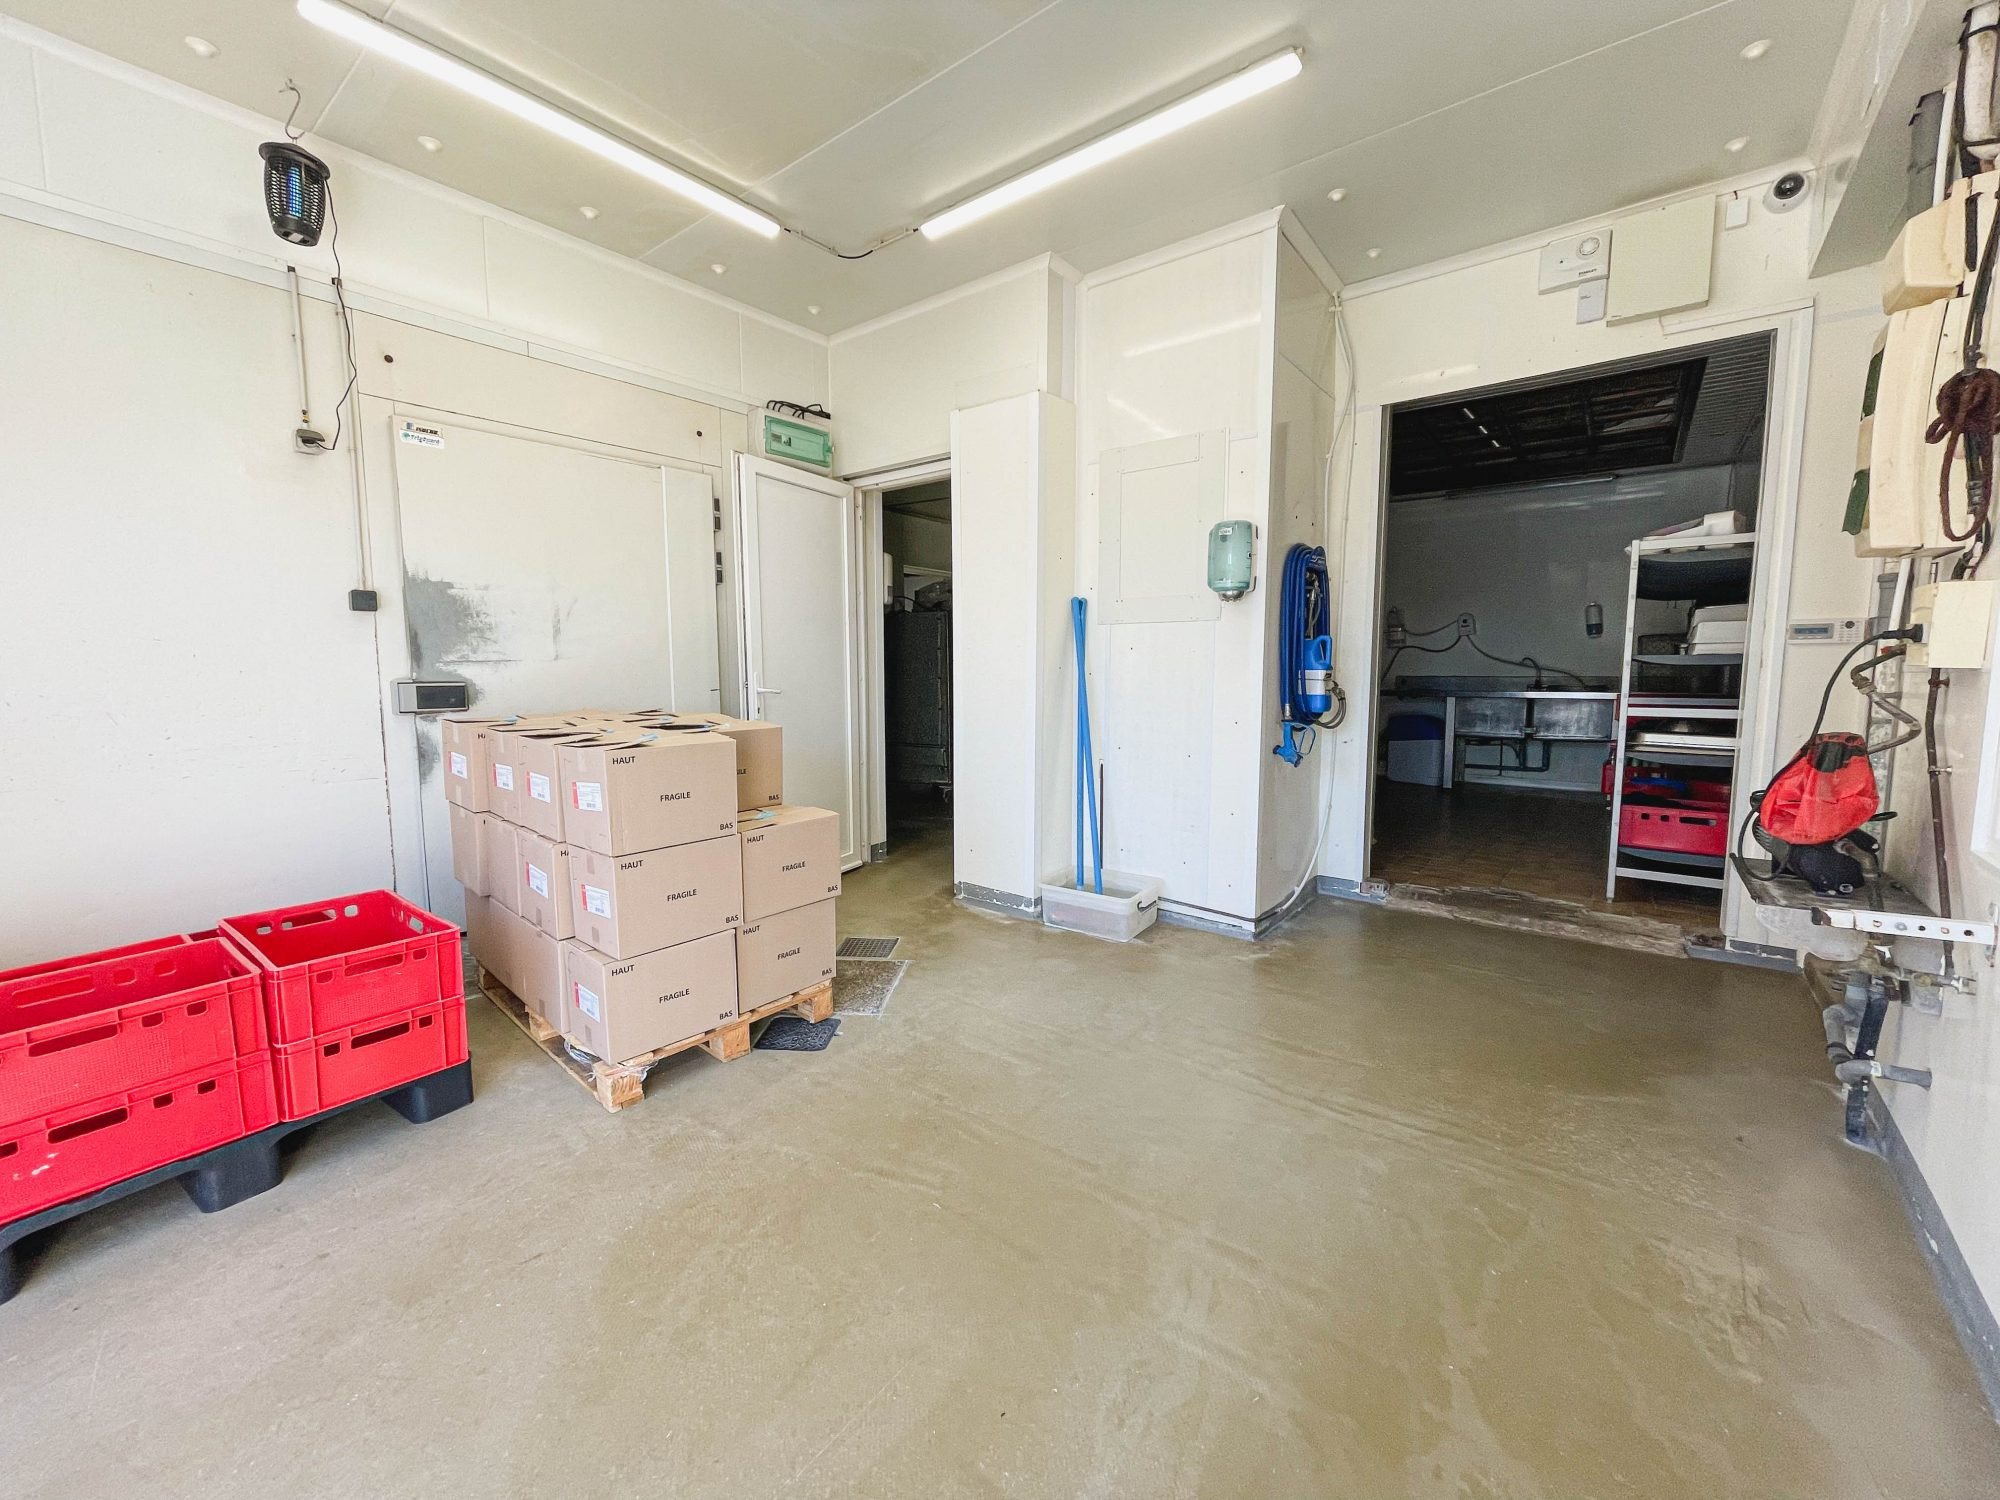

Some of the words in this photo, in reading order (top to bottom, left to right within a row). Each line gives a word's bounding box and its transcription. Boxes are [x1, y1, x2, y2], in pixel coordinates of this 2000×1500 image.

[612, 755, 636, 765] HAUT
[659, 791, 691, 803] FRAGILE
[768, 793, 780, 802] BAS
[719, 822, 734, 831] BAS
[746, 834, 765, 844] HAUT
[620, 859, 644, 871] HAUT
[782, 860, 806, 872] FRAGILE
[827, 884, 839, 893] BAS
[666, 888, 698, 902] FRAGILE
[725, 914, 739, 924] BAS
[742, 924, 761, 936] HAUT
[777, 946, 801, 961] FRAGILE
[611, 964, 635, 977] HAUT
[821, 967, 833, 977] BAS
[658, 988, 691, 1004] FRAGILE
[719, 1009, 733, 1021] BAS
